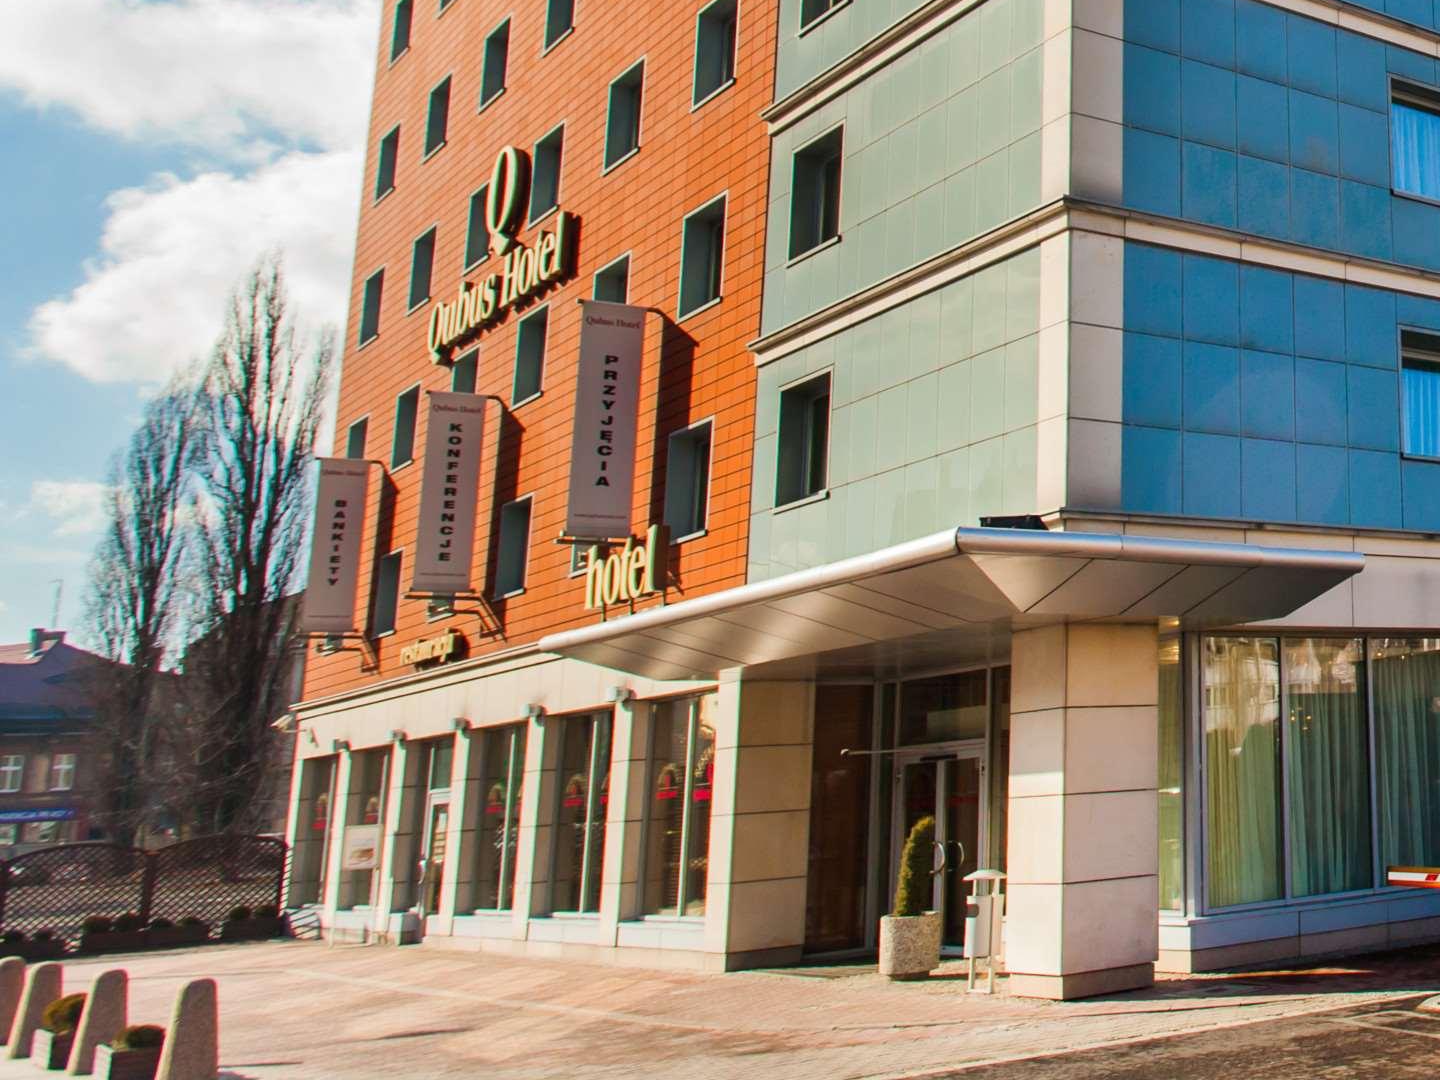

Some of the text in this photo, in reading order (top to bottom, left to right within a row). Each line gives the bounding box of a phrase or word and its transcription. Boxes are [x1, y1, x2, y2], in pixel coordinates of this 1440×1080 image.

[486, 145, 518, 256] Q
[428, 211, 566, 365] Qubus Hotel
[327, 499, 348, 587] BANKIETY
[438, 422, 463, 562] KONFERENCJE
[584, 523, 659, 610] hotel
